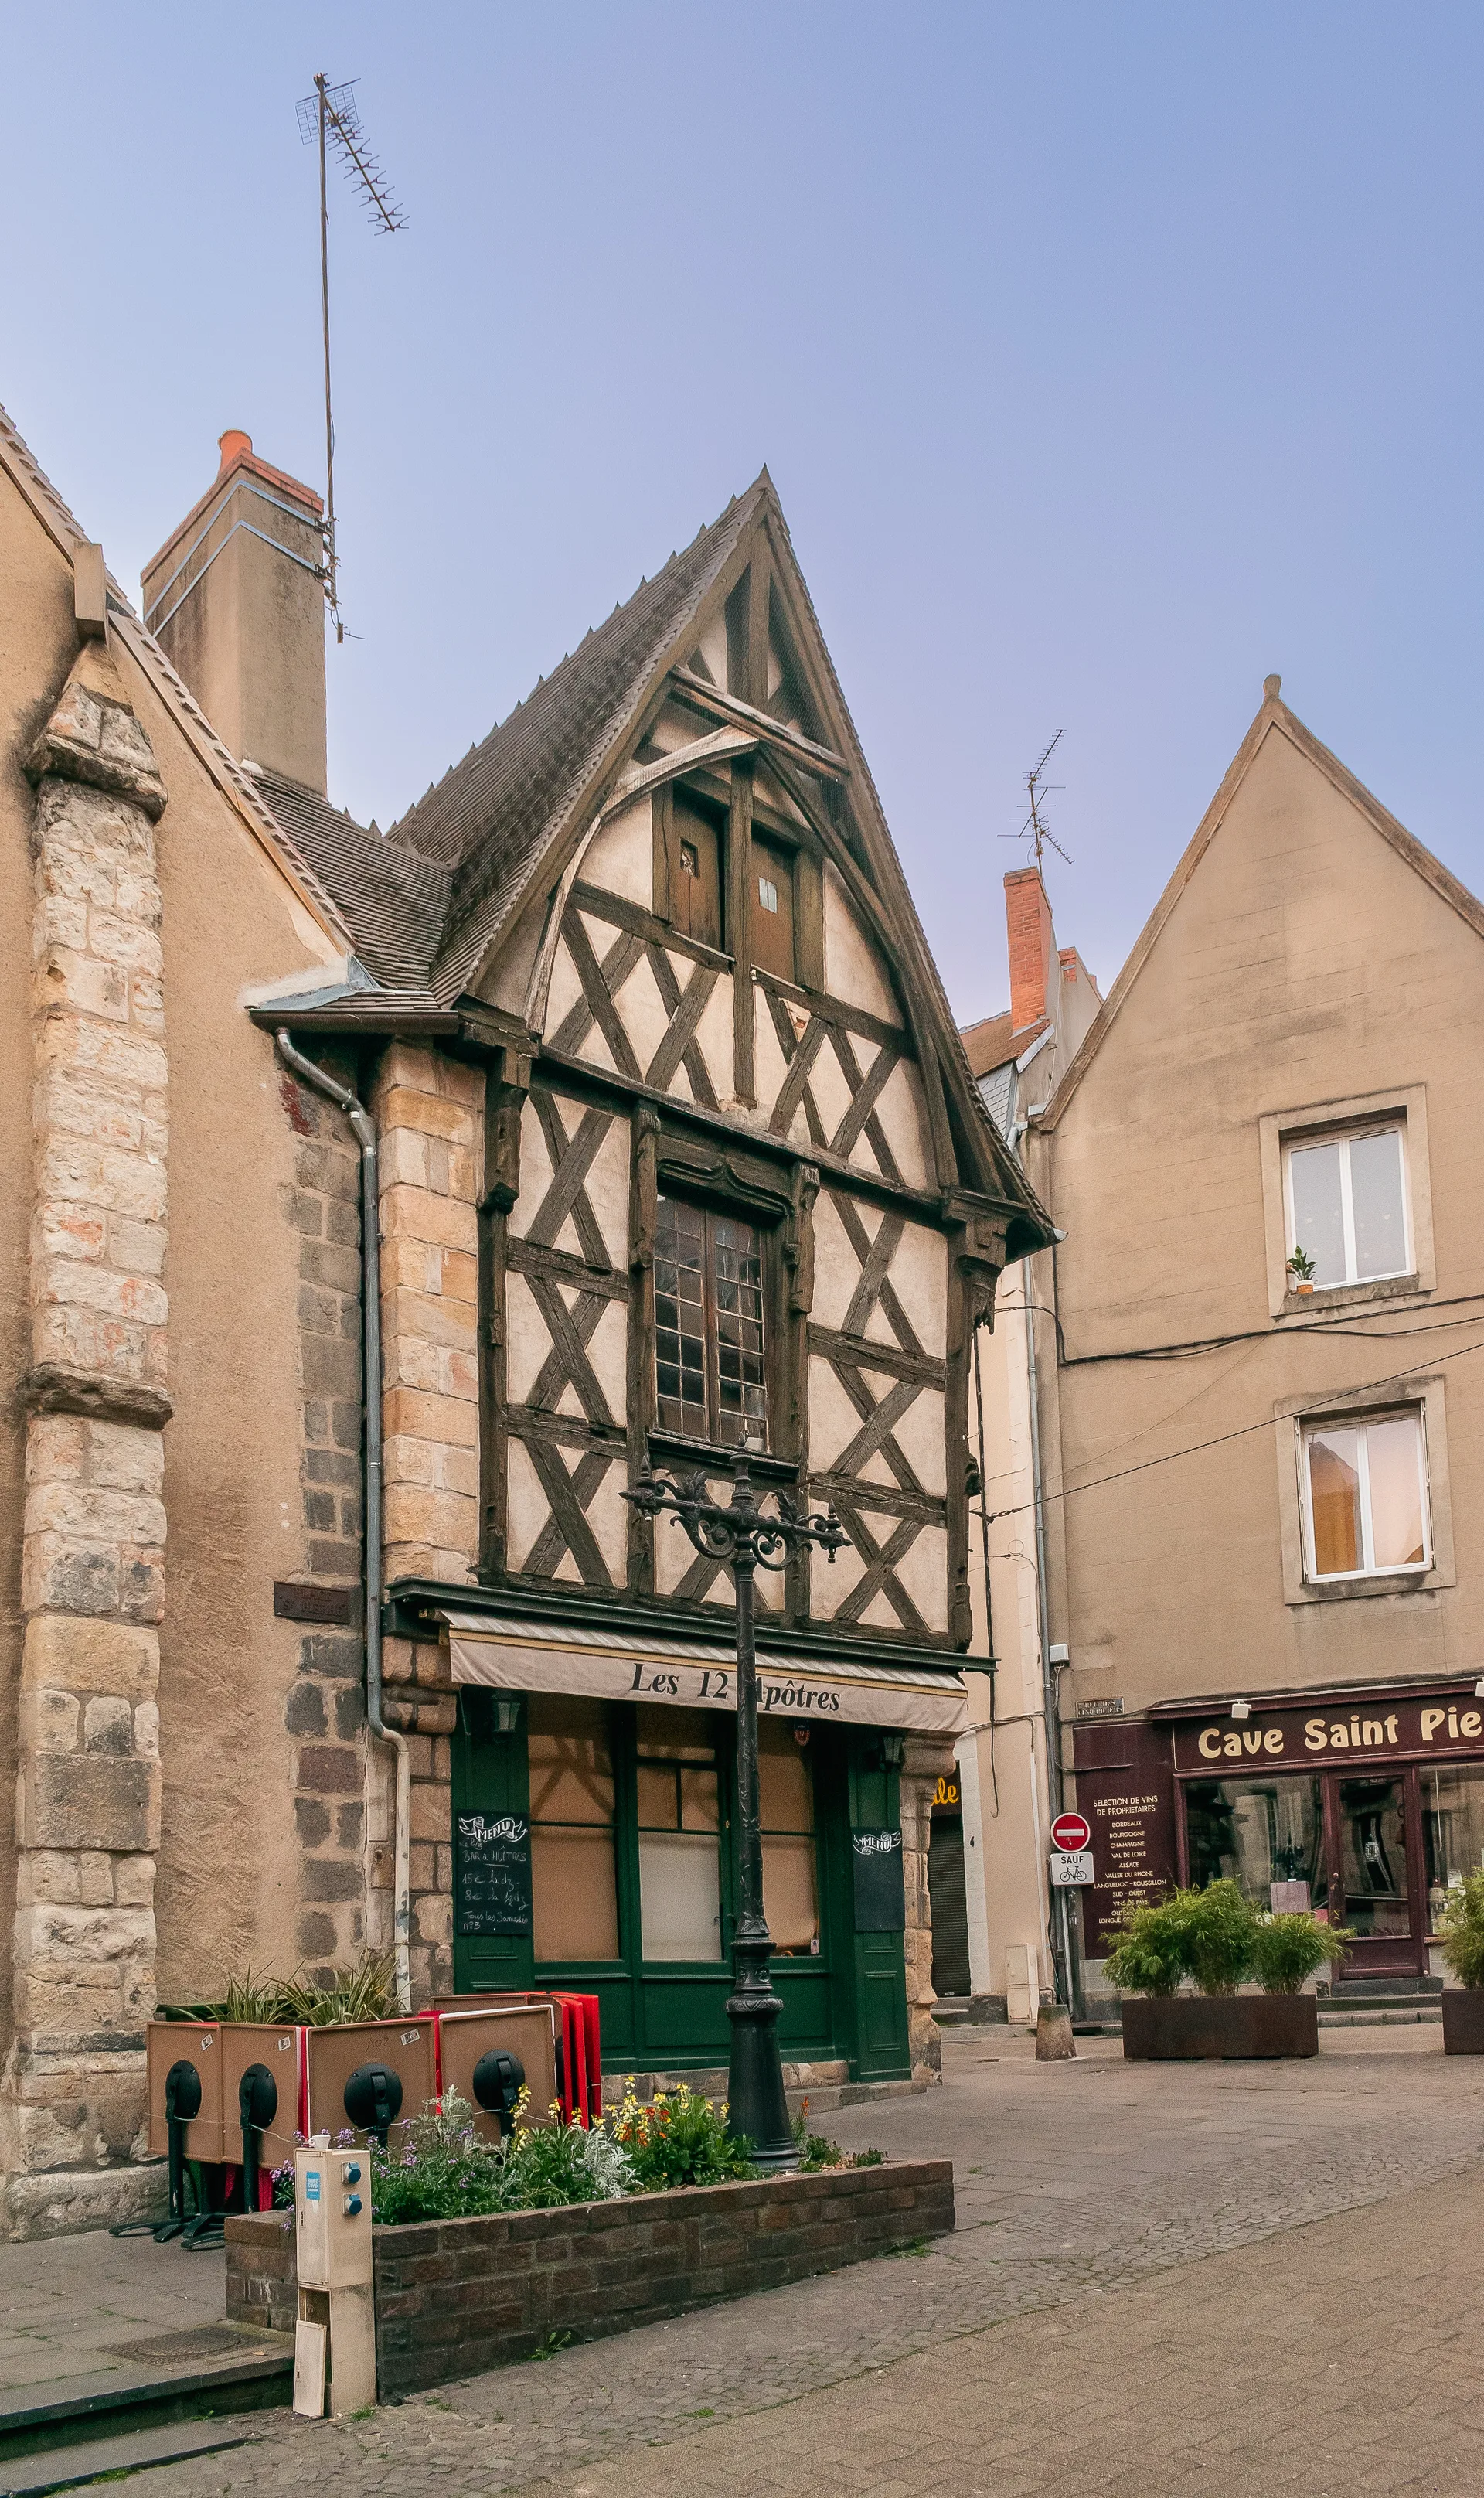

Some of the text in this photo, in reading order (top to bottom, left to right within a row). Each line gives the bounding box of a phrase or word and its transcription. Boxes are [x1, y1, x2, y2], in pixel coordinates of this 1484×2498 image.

[630, 1663, 679, 1695] Les
[698, 1671, 728, 1699] 12
[1198, 1706, 1482, 1758] Cave Saint Pie
[1093, 1798, 1128, 1808] SELECTION
[1108, 1804, 1156, 1815] PROPRIETAIRES
[477, 1821, 510, 1841] MENU
[863, 1836, 890, 1851] MENU
[1060, 1855, 1084, 1865] SAUF
